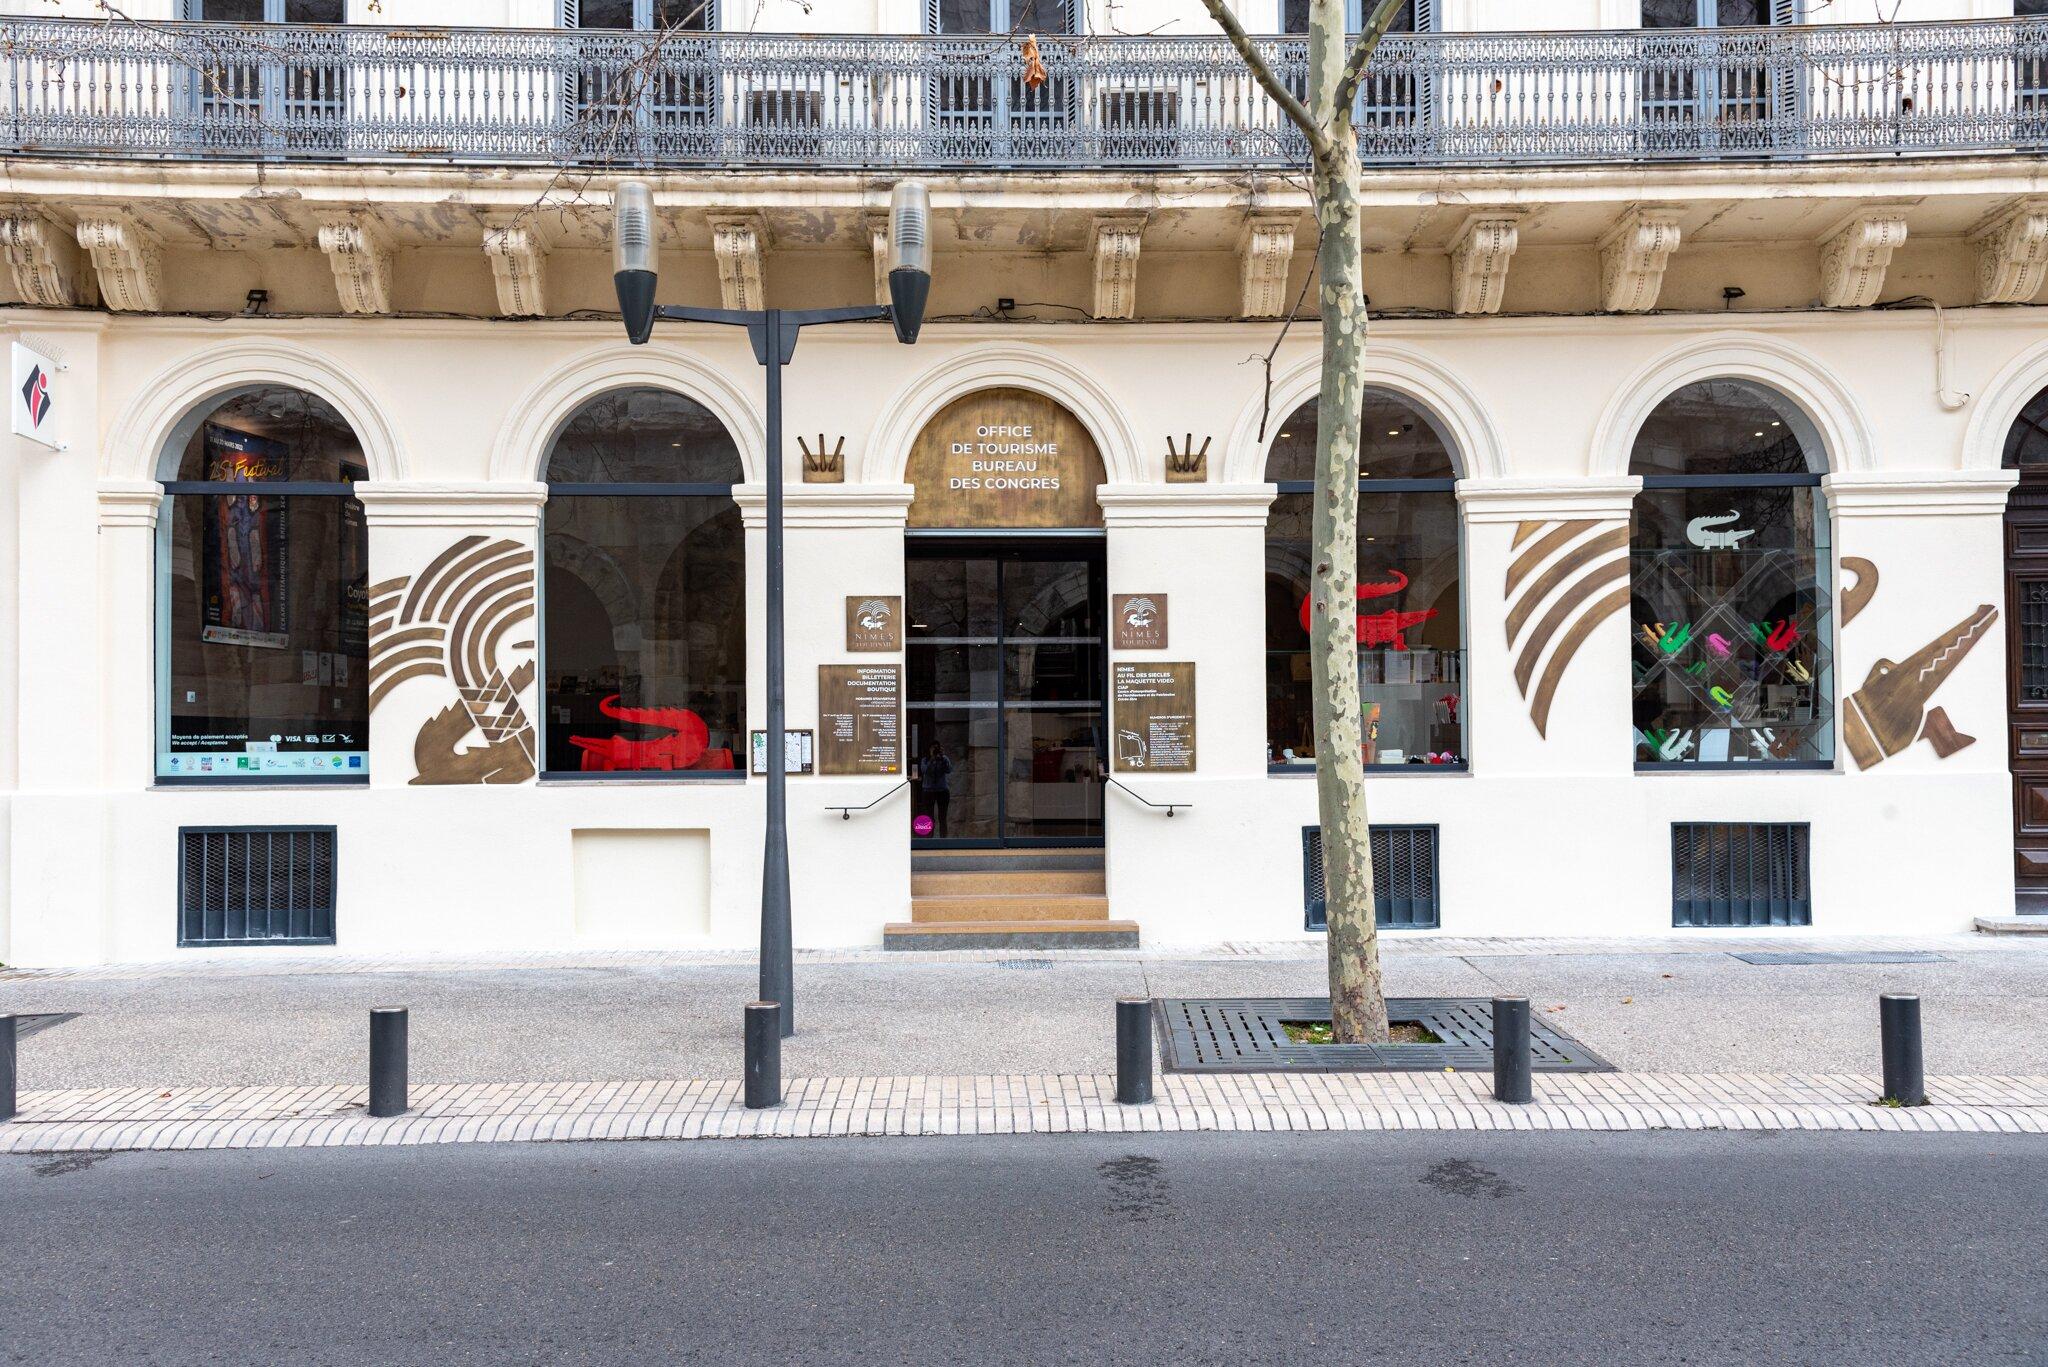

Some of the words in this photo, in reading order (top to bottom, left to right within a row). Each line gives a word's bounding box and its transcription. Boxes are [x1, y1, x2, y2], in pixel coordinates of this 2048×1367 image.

[977, 425, 1032, 437] OFFICE
[952, 443, 972, 454] DE
[977, 443, 1058, 455] TOURISME
[972, 460, 1037, 472] BUREAU
[950, 477, 980, 489] DES
